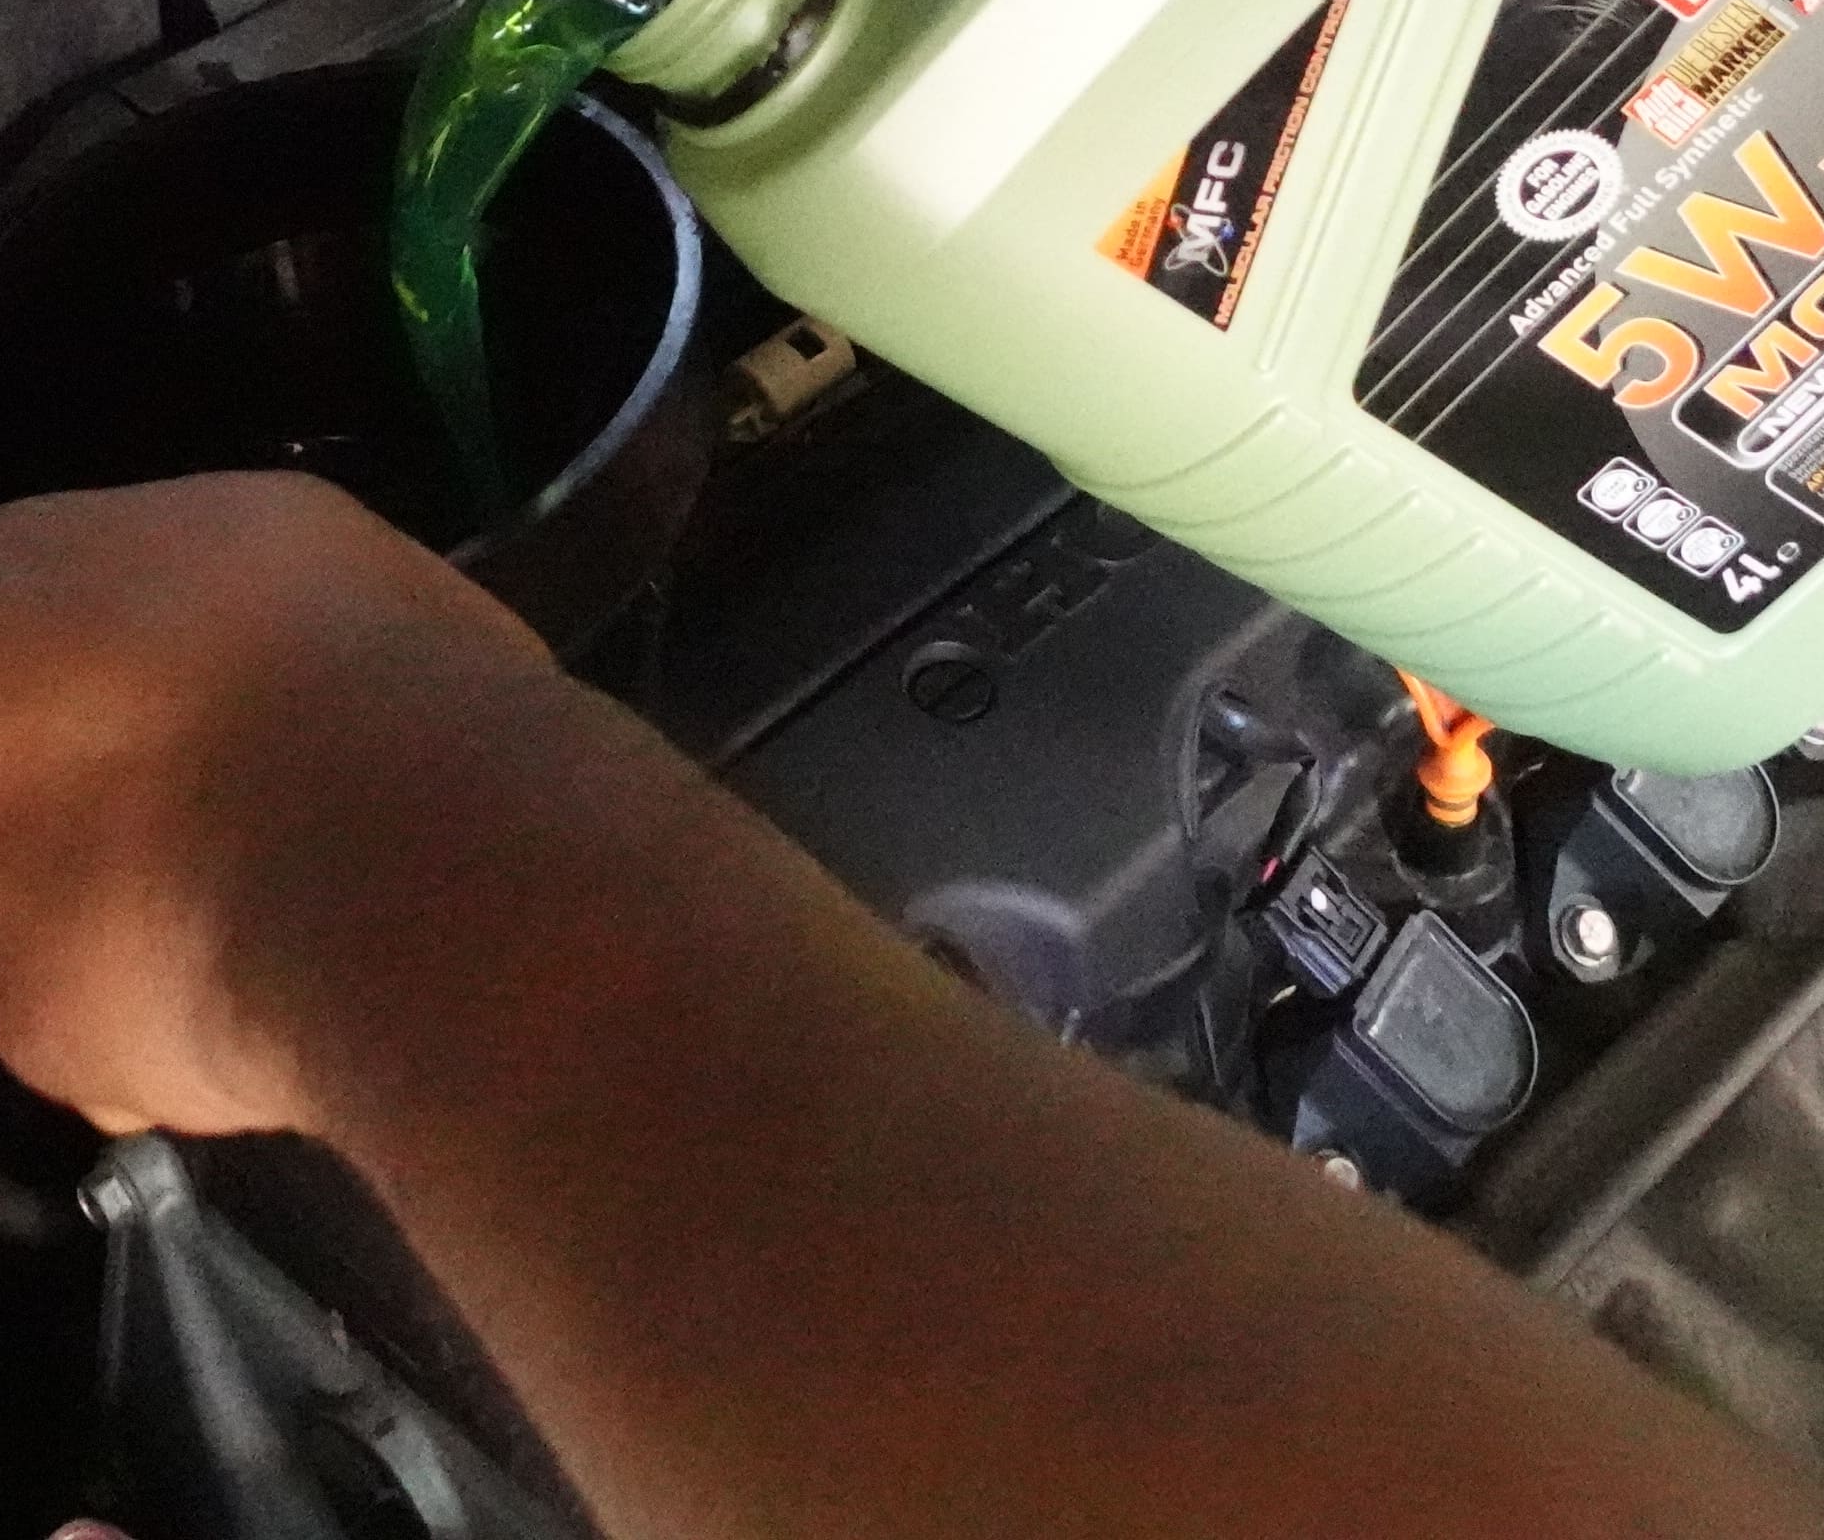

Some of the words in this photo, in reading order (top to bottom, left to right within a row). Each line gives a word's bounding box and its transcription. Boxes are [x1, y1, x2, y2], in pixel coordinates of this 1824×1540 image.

[1664, 51, 1705, 86] DIE
[1689, 16, 1778, 99] MARKEN
[1635, 77, 1686, 129] Auto
[1654, 94, 1708, 142] Bild
[1183, 138, 1246, 266] MFC
[1524, 150, 1590, 212] GASOLINE
[1525, 156, 1559, 188] FOR
[1541, 166, 1601, 221] ENGINES
[1116, 216, 1144, 262] Made
[1133, 200, 1147, 217] in
[1214, 193, 1272, 325] MOLECULAR
[1262, 94, 1309, 192] FRICTION
[1509, 228, 1617, 335] Advanced
[1606, 183, 1663, 235] Full
[1654, 83, 1765, 191] Synthetic
